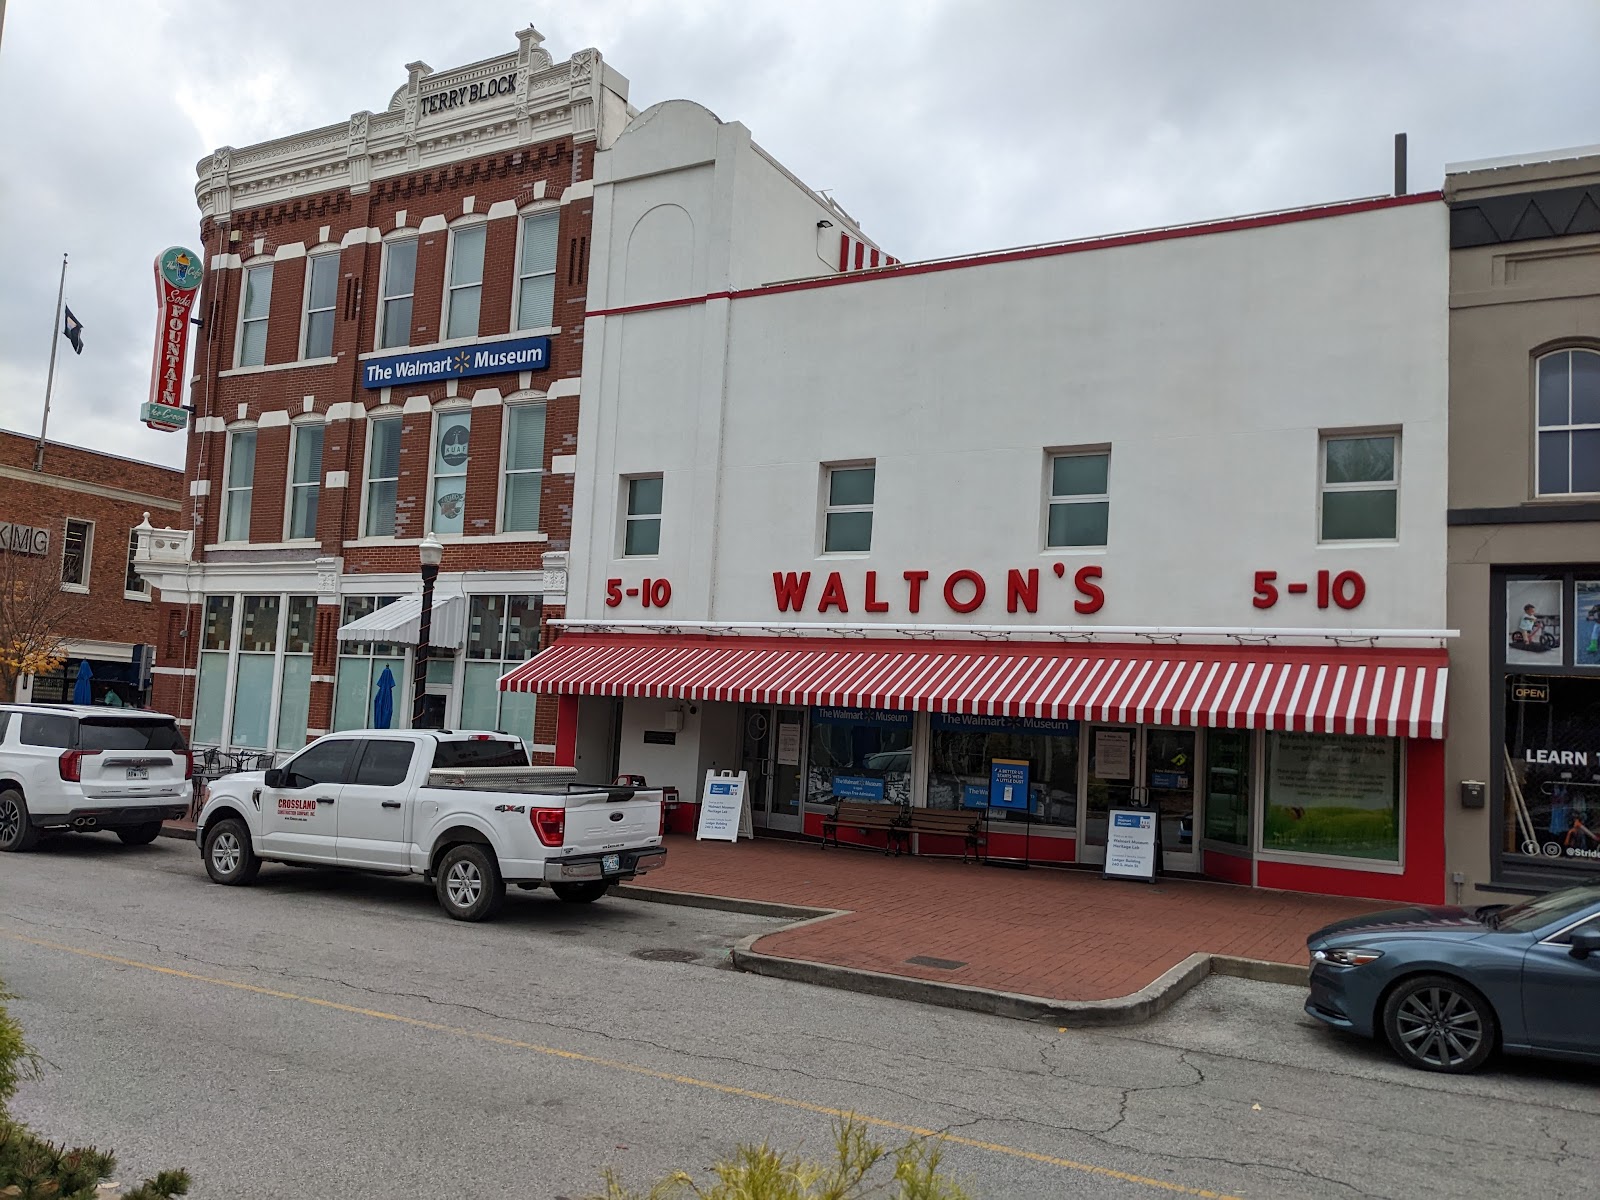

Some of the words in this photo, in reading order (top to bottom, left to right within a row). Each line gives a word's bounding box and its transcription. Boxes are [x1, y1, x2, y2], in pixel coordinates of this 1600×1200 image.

[421, 86, 468, 115] TERRY
[468, 73, 518, 102] BLOCK
[167, 289, 191, 308] Soda
[162, 305, 183, 405] FOUNTAIN
[367, 365, 392, 382] The
[395, 356, 452, 378] Walmart
[473, 347, 543, 369] Museum
[151, 406, 162, 417] Ice
[445, 445, 467, 454] KUAF
[606, 578, 672, 608] 5-10
[773, 563, 1105, 614] WALTON'S
[1253, 570, 1366, 609] 5-10
[1515, 688, 1545, 699] OPEN
[819, 708, 833, 718] The
[832, 709, 863, 720] Walmart
[875, 711, 908, 722] Museum
[941, 714, 961, 724] The
[962, 715, 1006, 727] Walmart
[1023, 718, 1069, 730] Museum
[1526, 748, 1588, 766] LEARN
[278, 798, 317, 810] CROSSLAND
